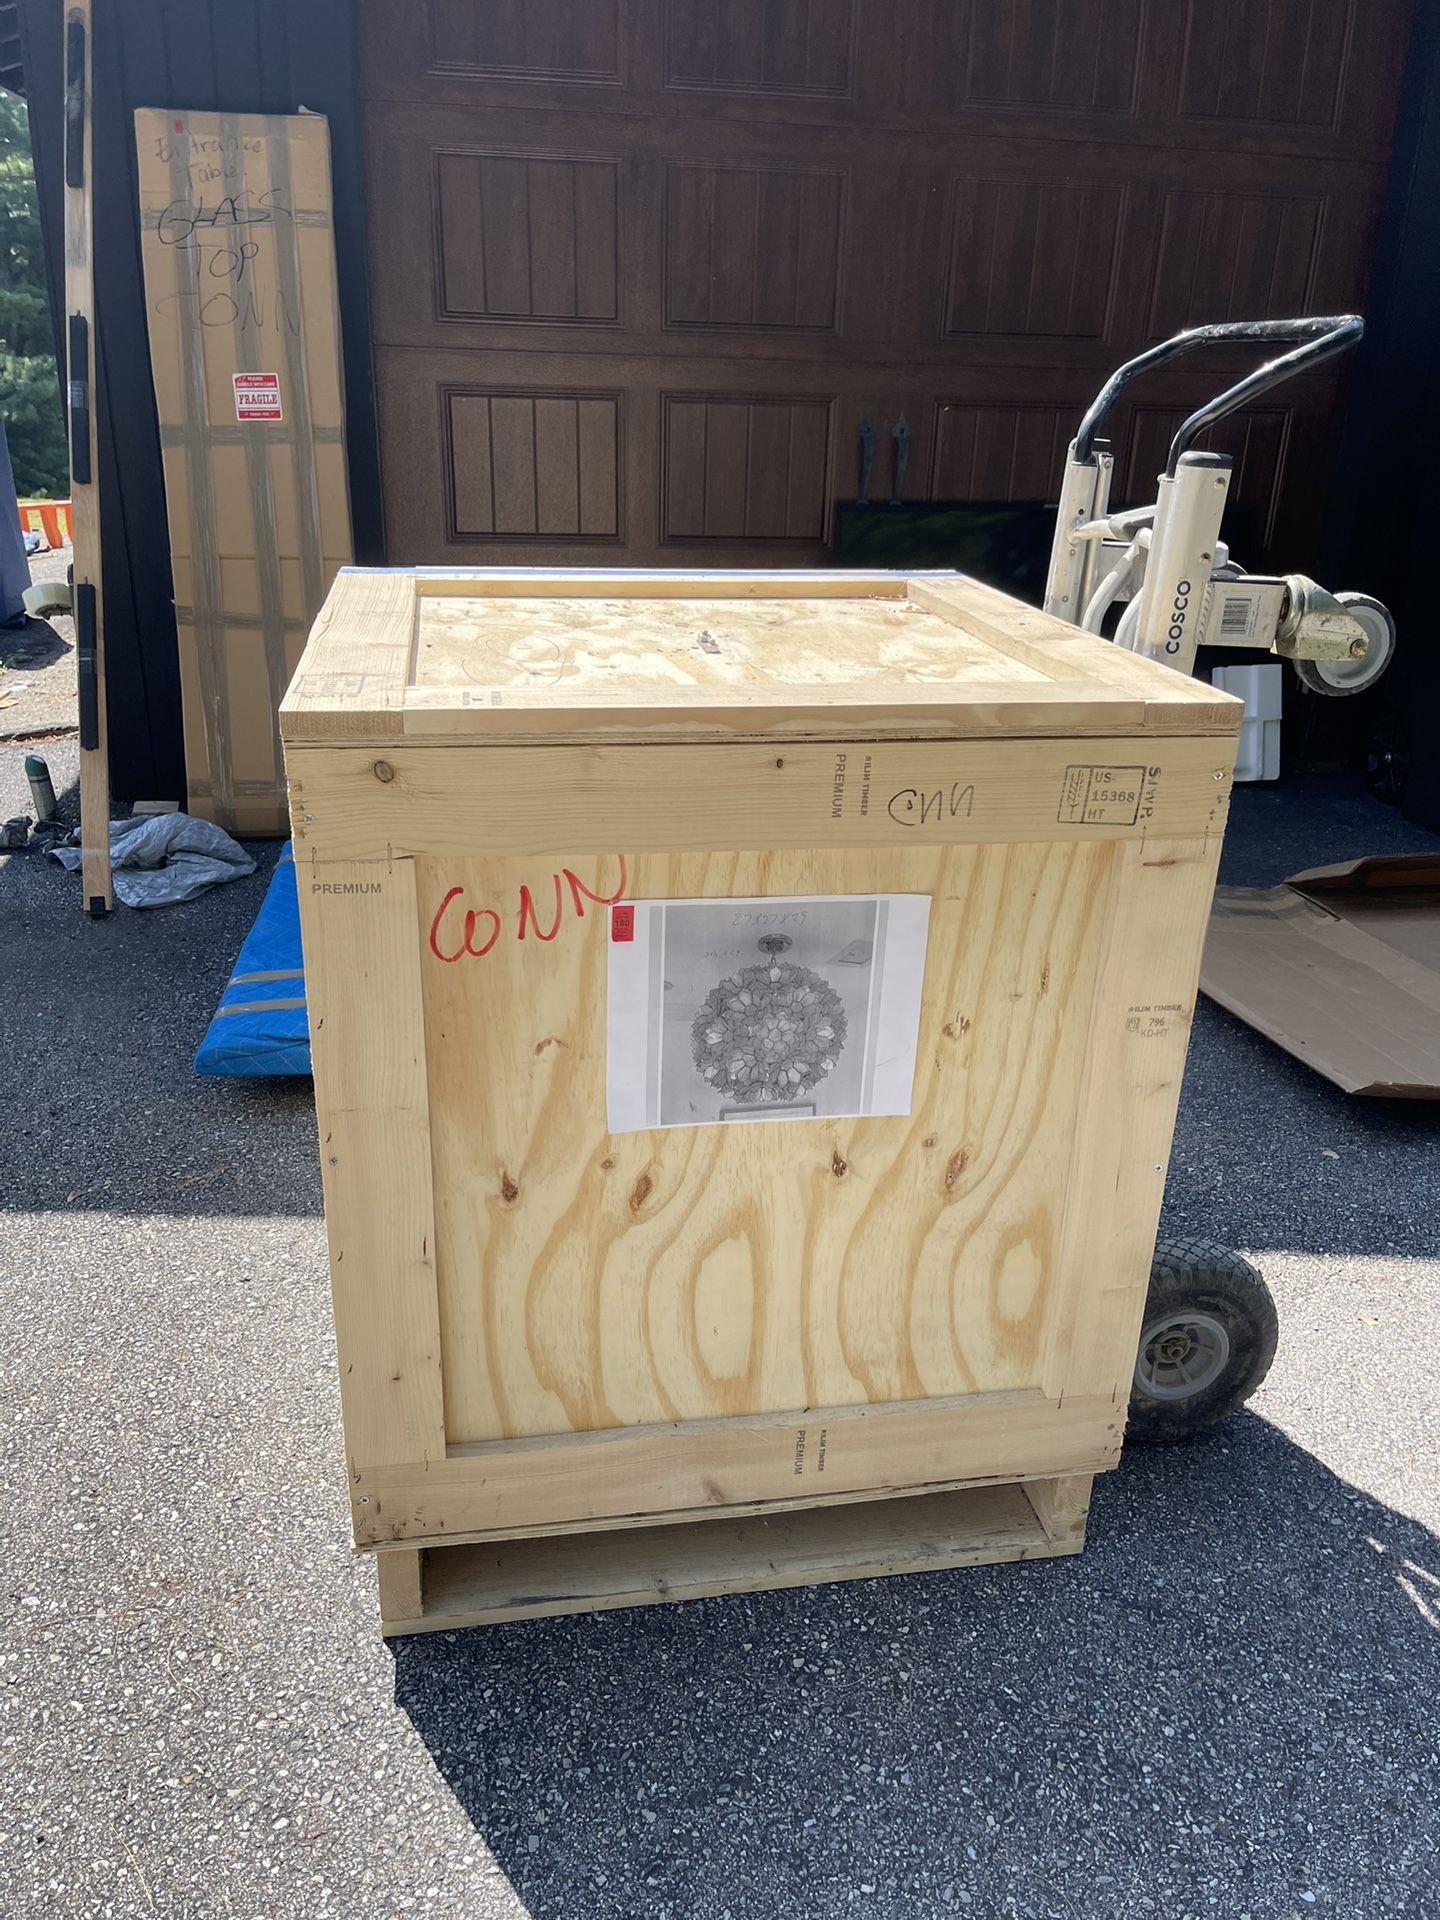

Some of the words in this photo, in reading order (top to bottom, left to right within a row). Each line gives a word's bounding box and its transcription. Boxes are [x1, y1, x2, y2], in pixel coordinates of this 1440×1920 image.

[176, 242, 259, 282] TOP
[238, 393, 278, 405] FRAGILE
[1165, 580, 1191, 654] COSCO
[831, 753, 847, 819] PREMIUM
[1090, 790, 1136, 803] 15368
[1087, 808, 1106, 820] HT
[311, 883, 383, 895] PREMIUM
[429, 853, 628, 964] CONN
[794, 1430, 806, 1474] PREMIUM
